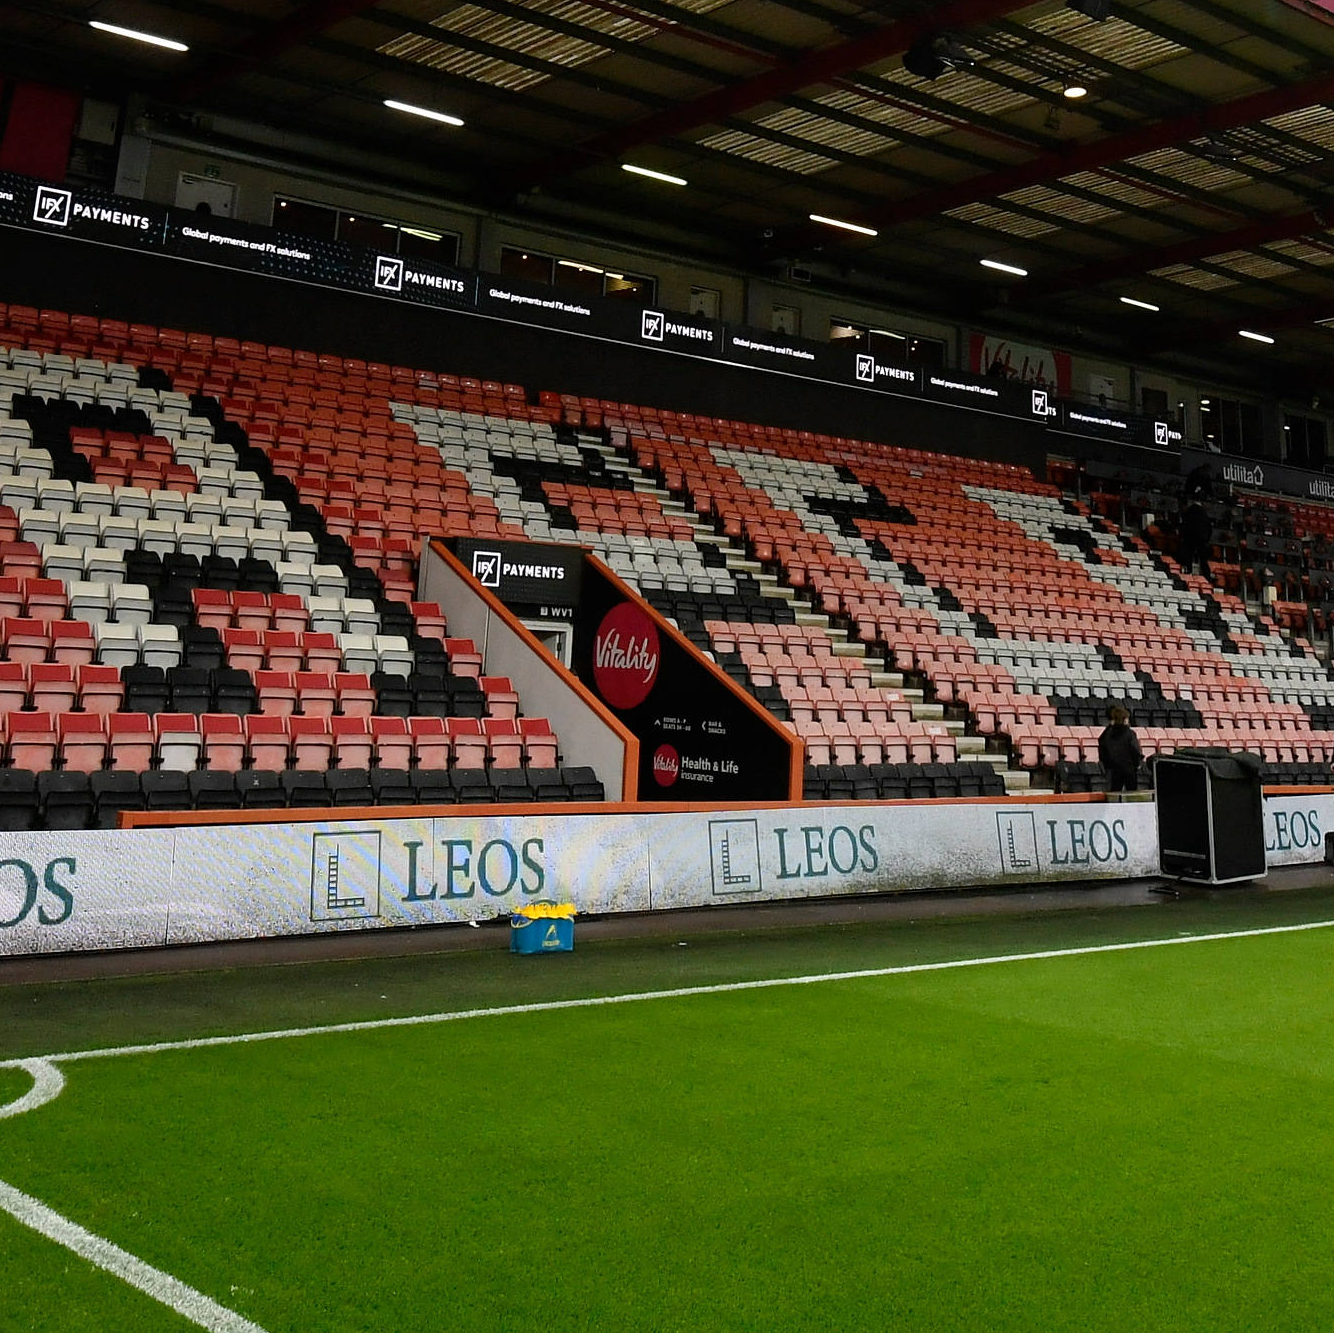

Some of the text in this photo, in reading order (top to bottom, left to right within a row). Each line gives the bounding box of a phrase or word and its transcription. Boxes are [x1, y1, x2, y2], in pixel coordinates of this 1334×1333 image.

[73, 203, 149, 230] PAYMENTS
[182, 226, 311, 261] Global payments and FX solutions
[405, 270, 465, 293] PAYMENTS
[489, 288, 510, 300] Global
[665, 323, 713, 341] PAYMENTS
[875, 365, 914, 381] PAYMENTS
[1223, 464, 1254, 484] utilita
[503, 563, 565, 580] PAYMENTS
[596, 628, 657, 683] Vitality
[653, 753, 679, 777] Vitality
[681, 769, 714, 782] insurance
[682, 756, 739, 774] Health & Life
[773, 824, 879, 880] LEOS
[1047, 819, 1129, 864] LEOS
[401, 837, 546, 902] LEOS
